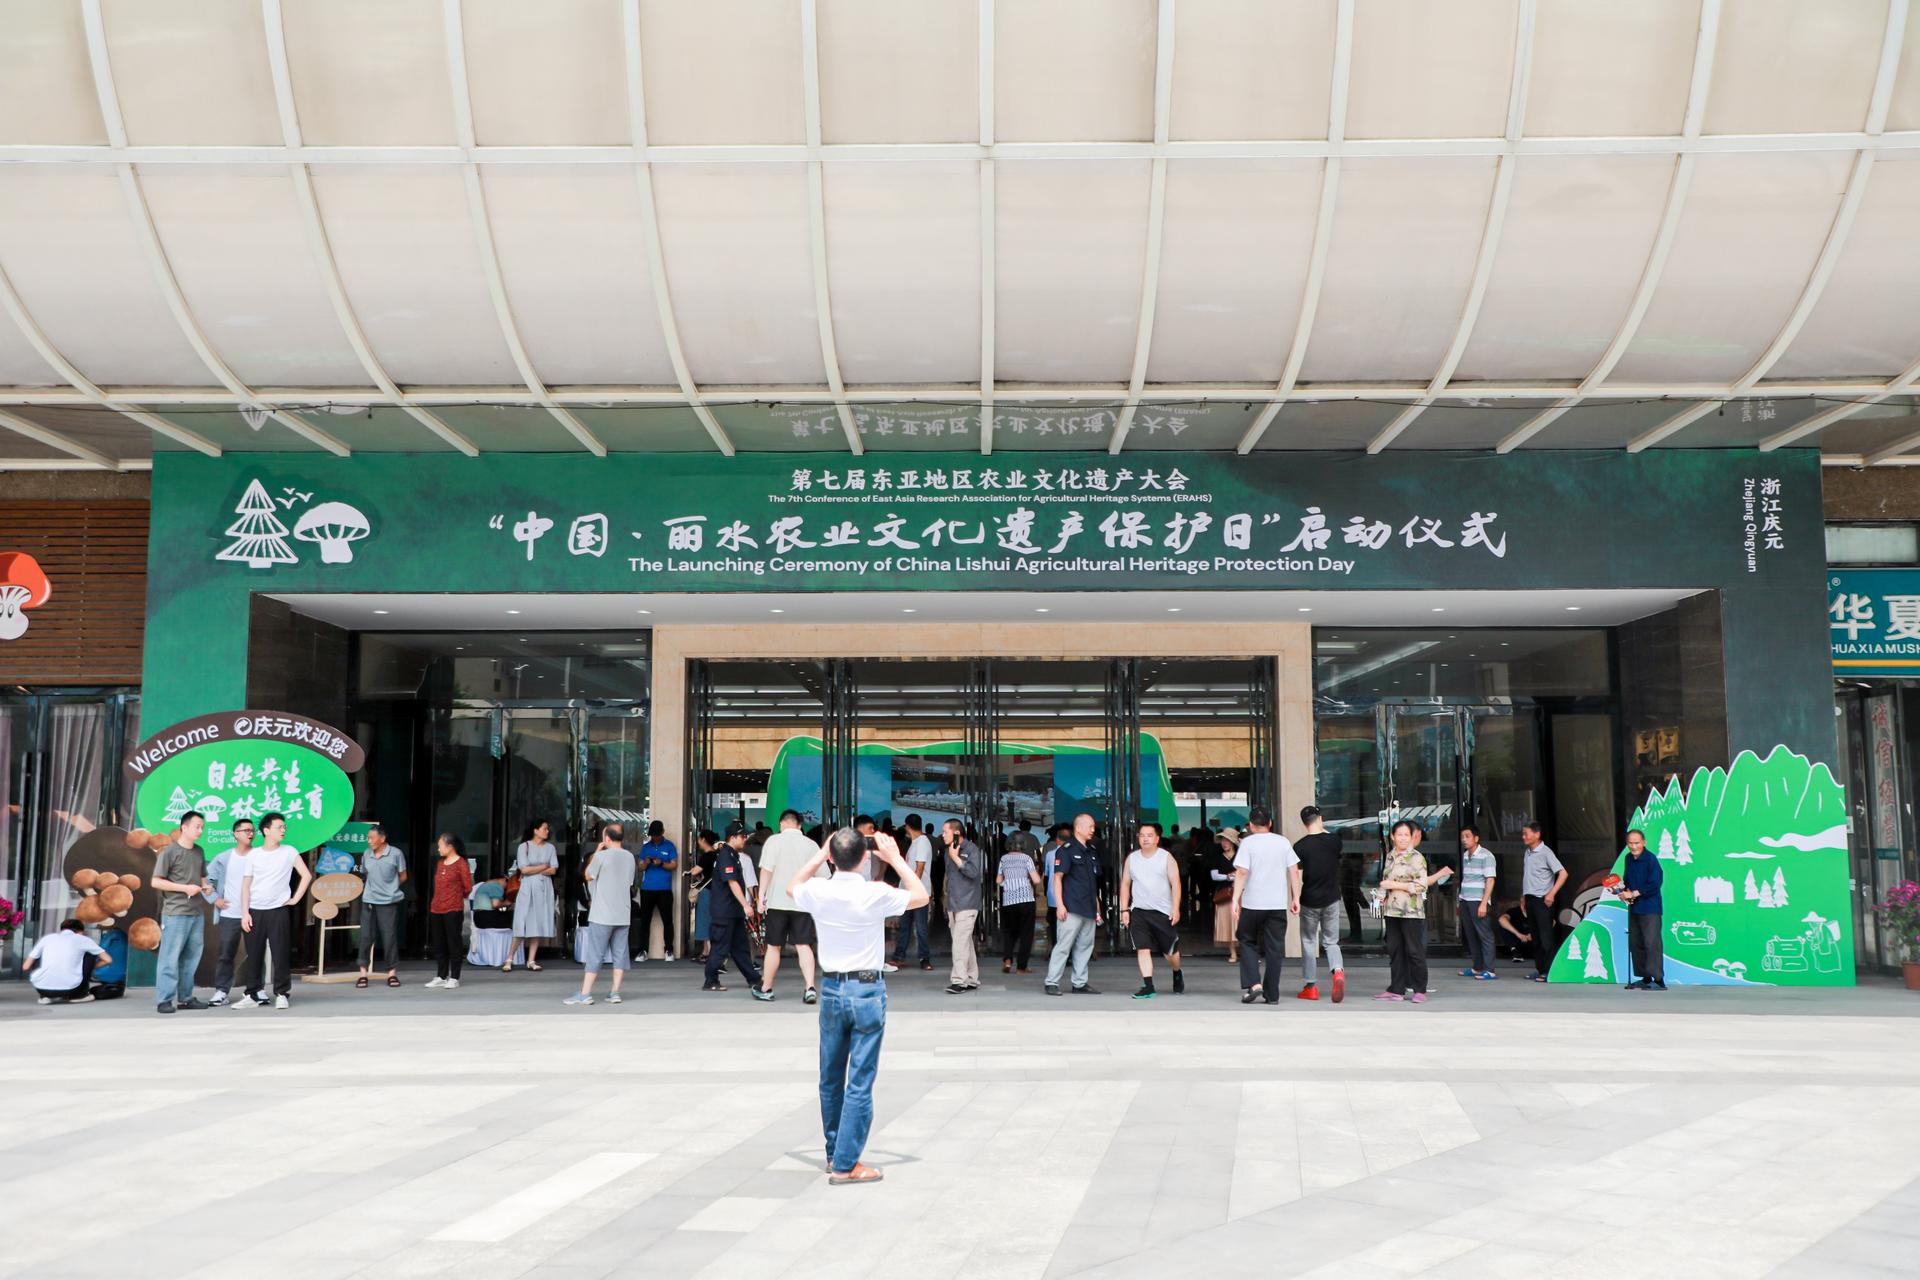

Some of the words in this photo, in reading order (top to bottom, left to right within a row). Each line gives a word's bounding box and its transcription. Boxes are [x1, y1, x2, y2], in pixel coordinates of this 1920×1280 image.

[768, 495, 786, 503] The
[787, 494, 803, 503] 7th
[804, 494, 860, 503] Conference
[861, 494, 871, 503] of
[872, 494, 893, 503] East
[894, 494, 915, 503] Asia
[916, 494, 960, 503] Research
[961, 494, 1017, 503] Association
[1018, 494, 1032, 503] for
[1033, 494, 1088, 504] Agricultural
[1089, 494, 1129, 504] Heritage
[1130, 494, 1171, 504] Systems
[1173, 494, 1213, 504] (ERAHS)
[790, 468, 1190, 491] 第七届东亚地区农业文化遗产大会
[1743, 478, 1756, 521] Zhejiang
[1760, 478, 1784, 550] 浙江庆元
[628, 557, 663, 572] The
[667, 557, 765, 575] Launching
[769, 557, 868, 575] Ceremony
[873, 557, 892, 572] of
[896, 556, 951, 571] China
[955, 556, 1010, 571] Lishui
[1014, 556, 1125, 575] Agricultural
[1129, 556, 1210, 575] Heritage
[1214, 556, 1314, 571] Protection
[1318, 556, 1355, 575] Day
[1744, 523, 1757, 572] Qingyuan
[1829, 593, 1920, 640] 华夏
[129, 724, 219, 774] Welcome
[254, 716, 349, 759] 庆元欢迎您
[208, 758, 301, 793] 自然共生
[229, 784, 324, 820] 林菇共育
